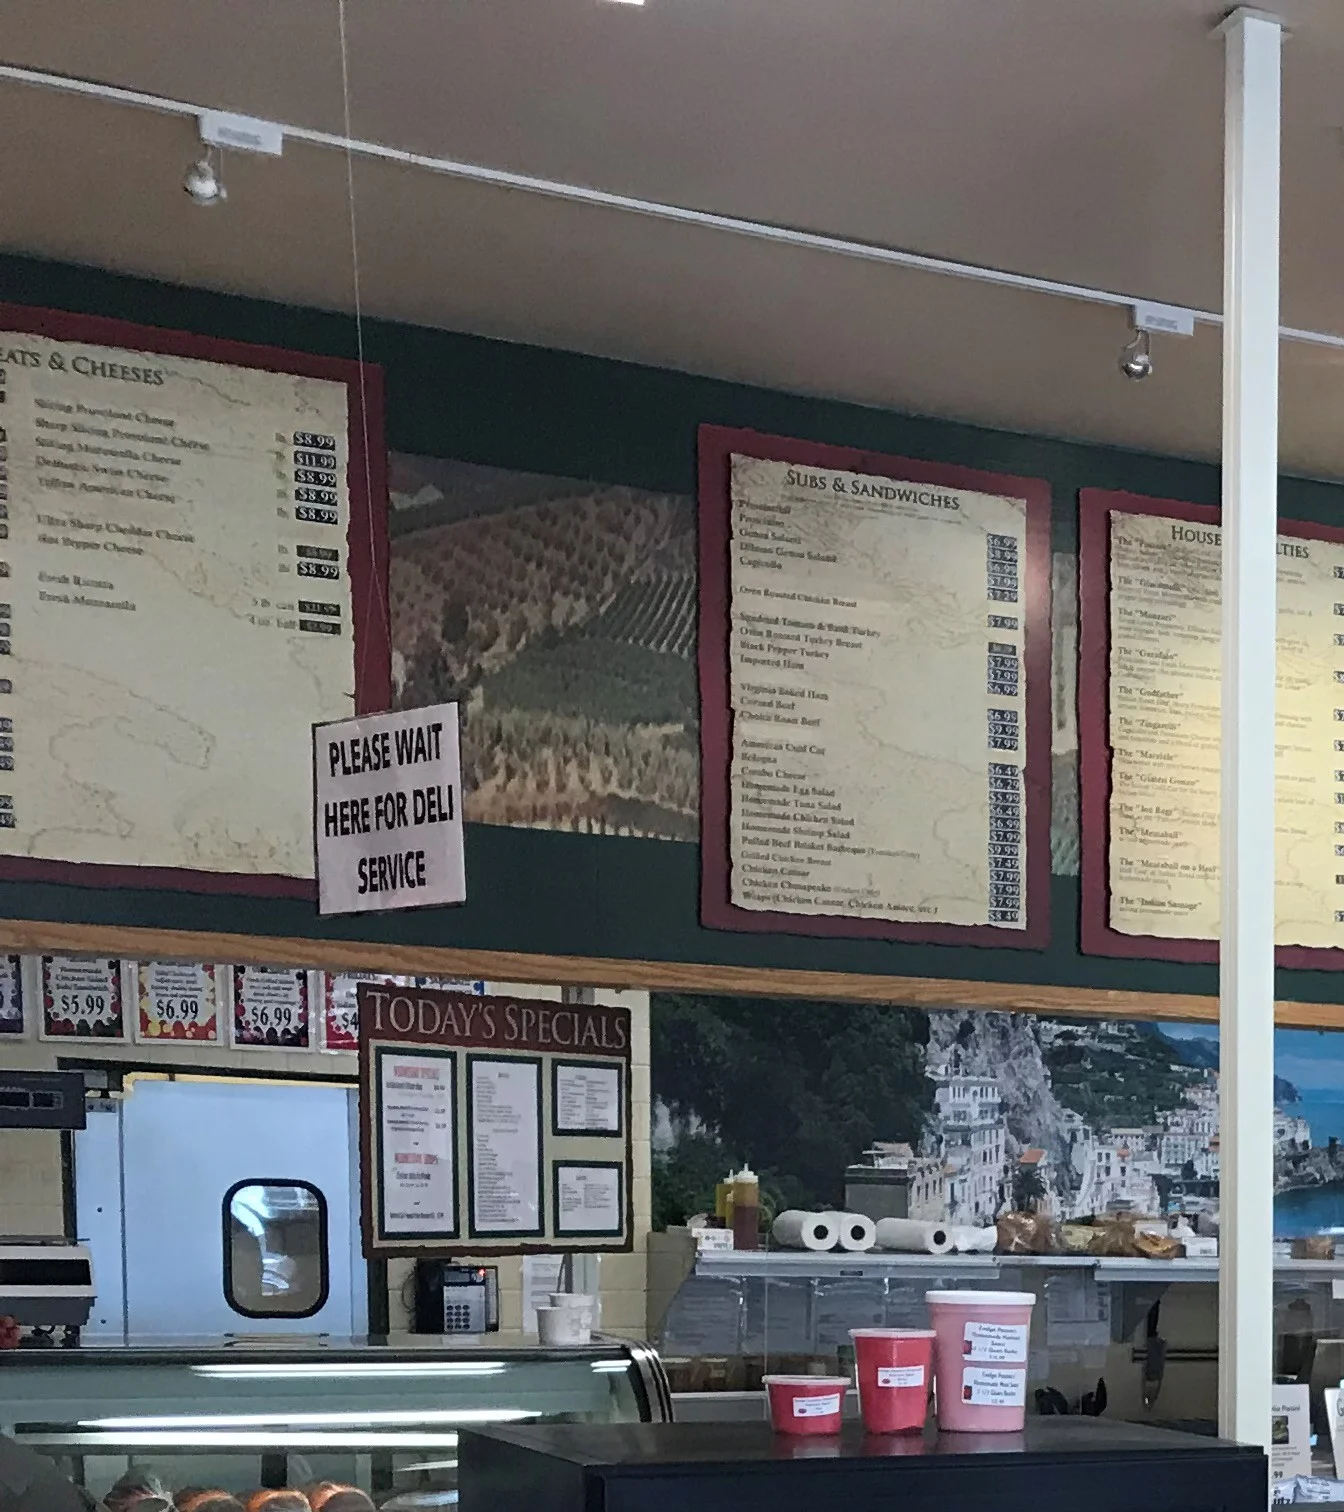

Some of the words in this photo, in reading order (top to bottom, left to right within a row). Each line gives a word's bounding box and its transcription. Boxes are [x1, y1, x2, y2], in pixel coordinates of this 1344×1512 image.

[0, 348, 41, 367] EATS
[48, 351, 65, 371] &
[71, 356, 164, 385] CHEESES
[294, 431, 336, 450] $8.99
[294, 451, 337, 470] $11.99
[294, 470, 337, 488] $8.99
[295, 489, 338, 506] $8.99
[786, 469, 827, 490] SUBS
[832, 478, 847, 493] &
[851, 481, 960, 511] SANDWICHES
[296, 507, 338, 525] $8.99
[1171, 525, 1222, 546] HOUSE
[298, 563, 339, 580] $8.99
[328, 729, 391, 777] PLEASE
[395, 724, 443, 766] WAIT
[324, 801, 370, 837] HERE
[376, 791, 409, 829] FOR
[413, 786, 454, 825] DELI
[357, 850, 427, 894] SERVICE
[61, 995, 105, 1016] $5.99
[156, 999, 200, 1020] $6.99
[251, 1006, 292, 1028] $6.99
[366, 991, 496, 1040] TODAY'S
[504, 1003, 626, 1049] SPECIALS
